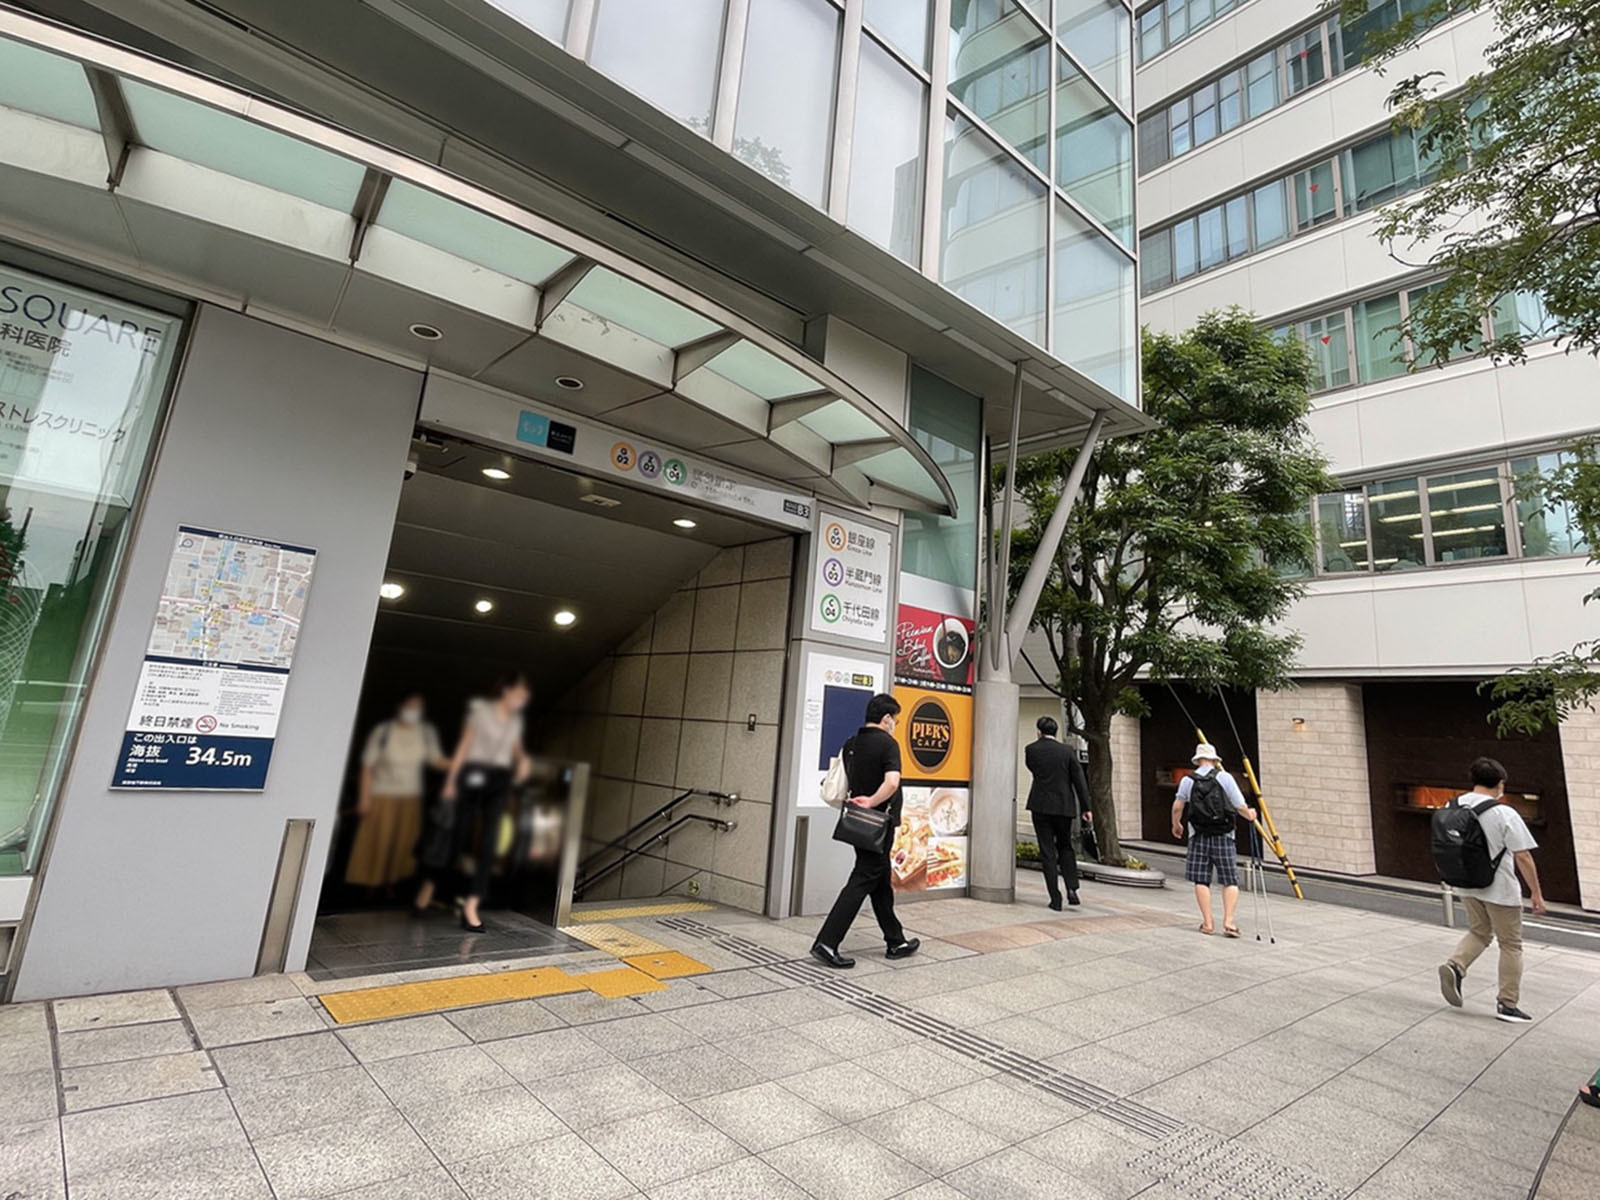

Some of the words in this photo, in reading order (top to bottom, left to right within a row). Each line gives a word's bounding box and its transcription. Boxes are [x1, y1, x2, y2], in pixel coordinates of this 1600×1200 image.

[0, 285, 162, 357] SQUARE
[0, 322, 73, 357] 科医院
[616, 453, 629, 465] 02
[643, 462, 656, 473] 02
[830, 535, 842, 546] 02
[843, 601, 880, 621] 千代田線
[139, 715, 194, 729] 終日禁煙
[231, 721, 260, 731] Smoking
[133, 733, 198, 745] この出入口は
[912, 722, 950, 743] PIER'S
[129, 744, 162, 758] 海抜
[185, 746, 252, 767] 34.5m
